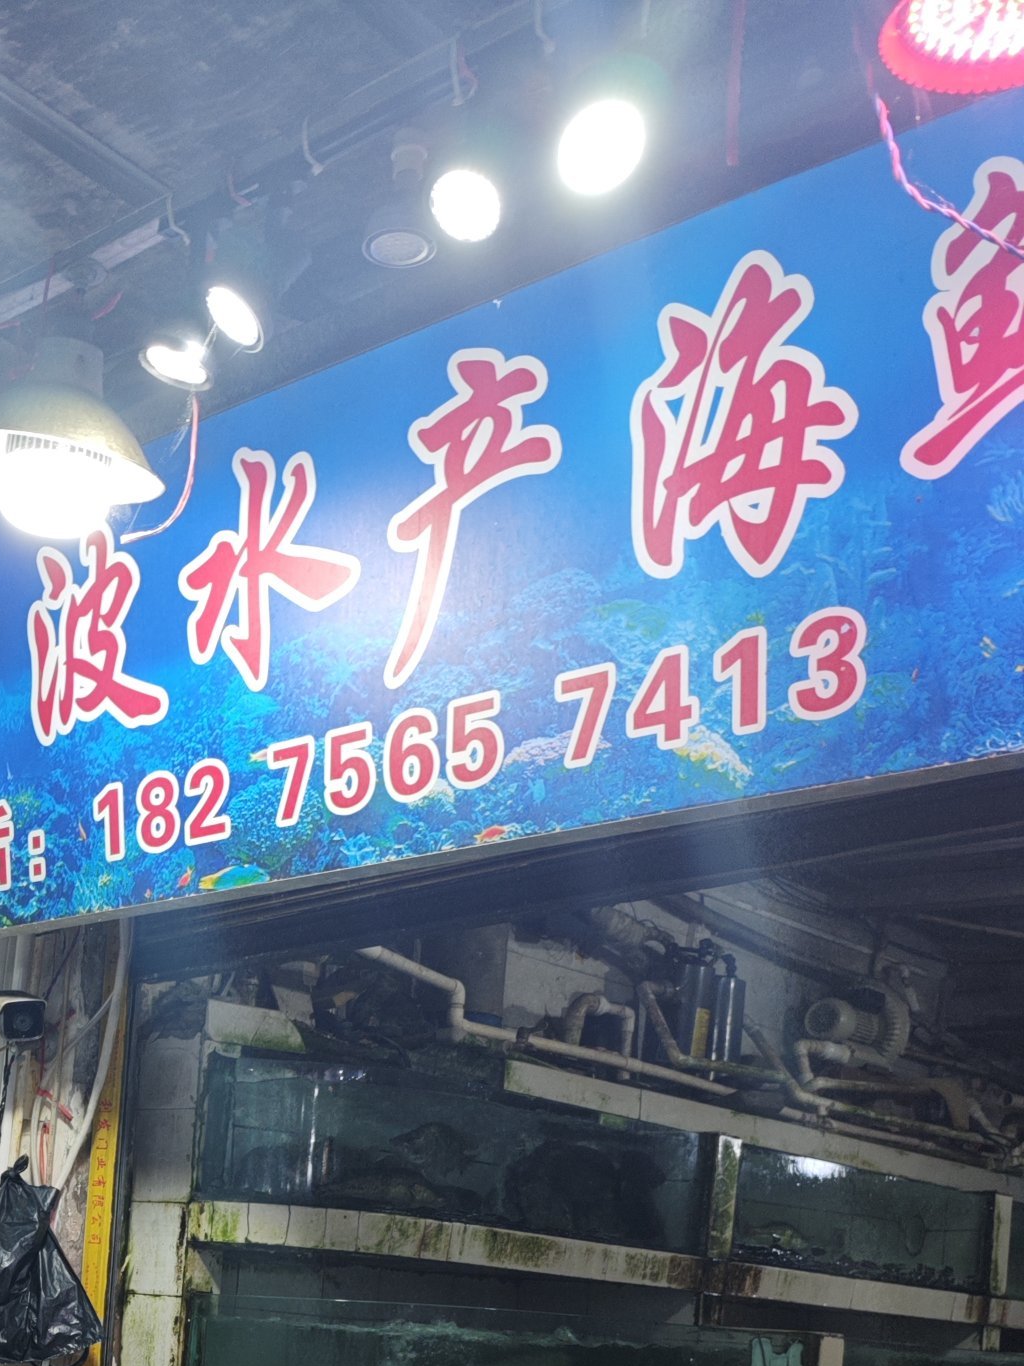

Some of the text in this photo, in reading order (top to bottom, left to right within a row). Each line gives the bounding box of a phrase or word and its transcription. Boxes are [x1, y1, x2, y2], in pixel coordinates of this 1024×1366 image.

[92, 757, 233, 863] 182
[267, 690, 506, 828] 7565
[555, 605, 869, 770] 7413
[88, 1098, 113, 1245] 利发门业有限公司
